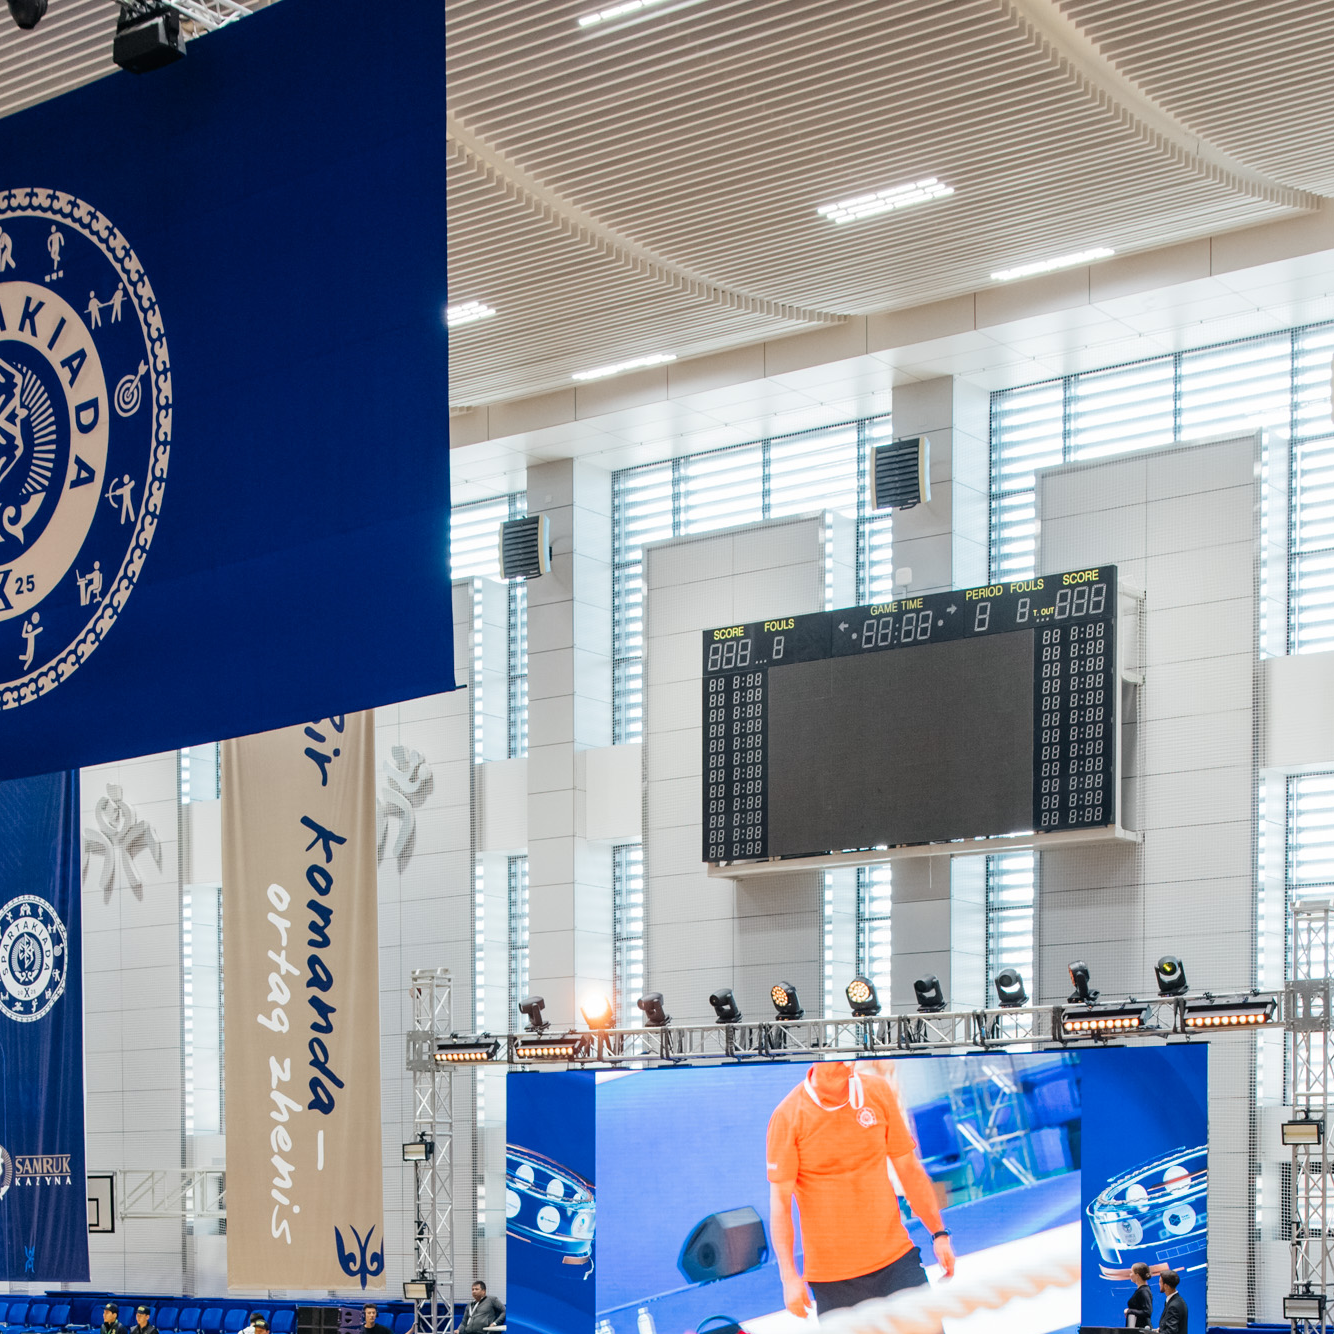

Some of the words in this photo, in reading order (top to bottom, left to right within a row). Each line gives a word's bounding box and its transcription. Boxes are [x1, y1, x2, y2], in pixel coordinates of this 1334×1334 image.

[14, 574, 36, 596] 25
[1063, 569, 1100, 586] SCORE
[966, 585, 1003, 601] PERIOD
[1010, 578, 1044, 594] FOULS
[870, 602, 898, 616] GAME
[901, 598, 924, 611] TIME
[1041, 606, 1054, 616] OUT
[713, 625, 744, 641] SCORE
[764, 618, 795, 633] FOULS
[1, 921, 51, 976] SPARTAKIADA
[257, 883, 293, 1034] ortaq
[300, 814, 348, 1116] komanda
[268, 1054, 304, 1247] zhenis
[15, 1157, 71, 1175] SAMRUK
[14, 1175, 72, 1187] KAZYNA
